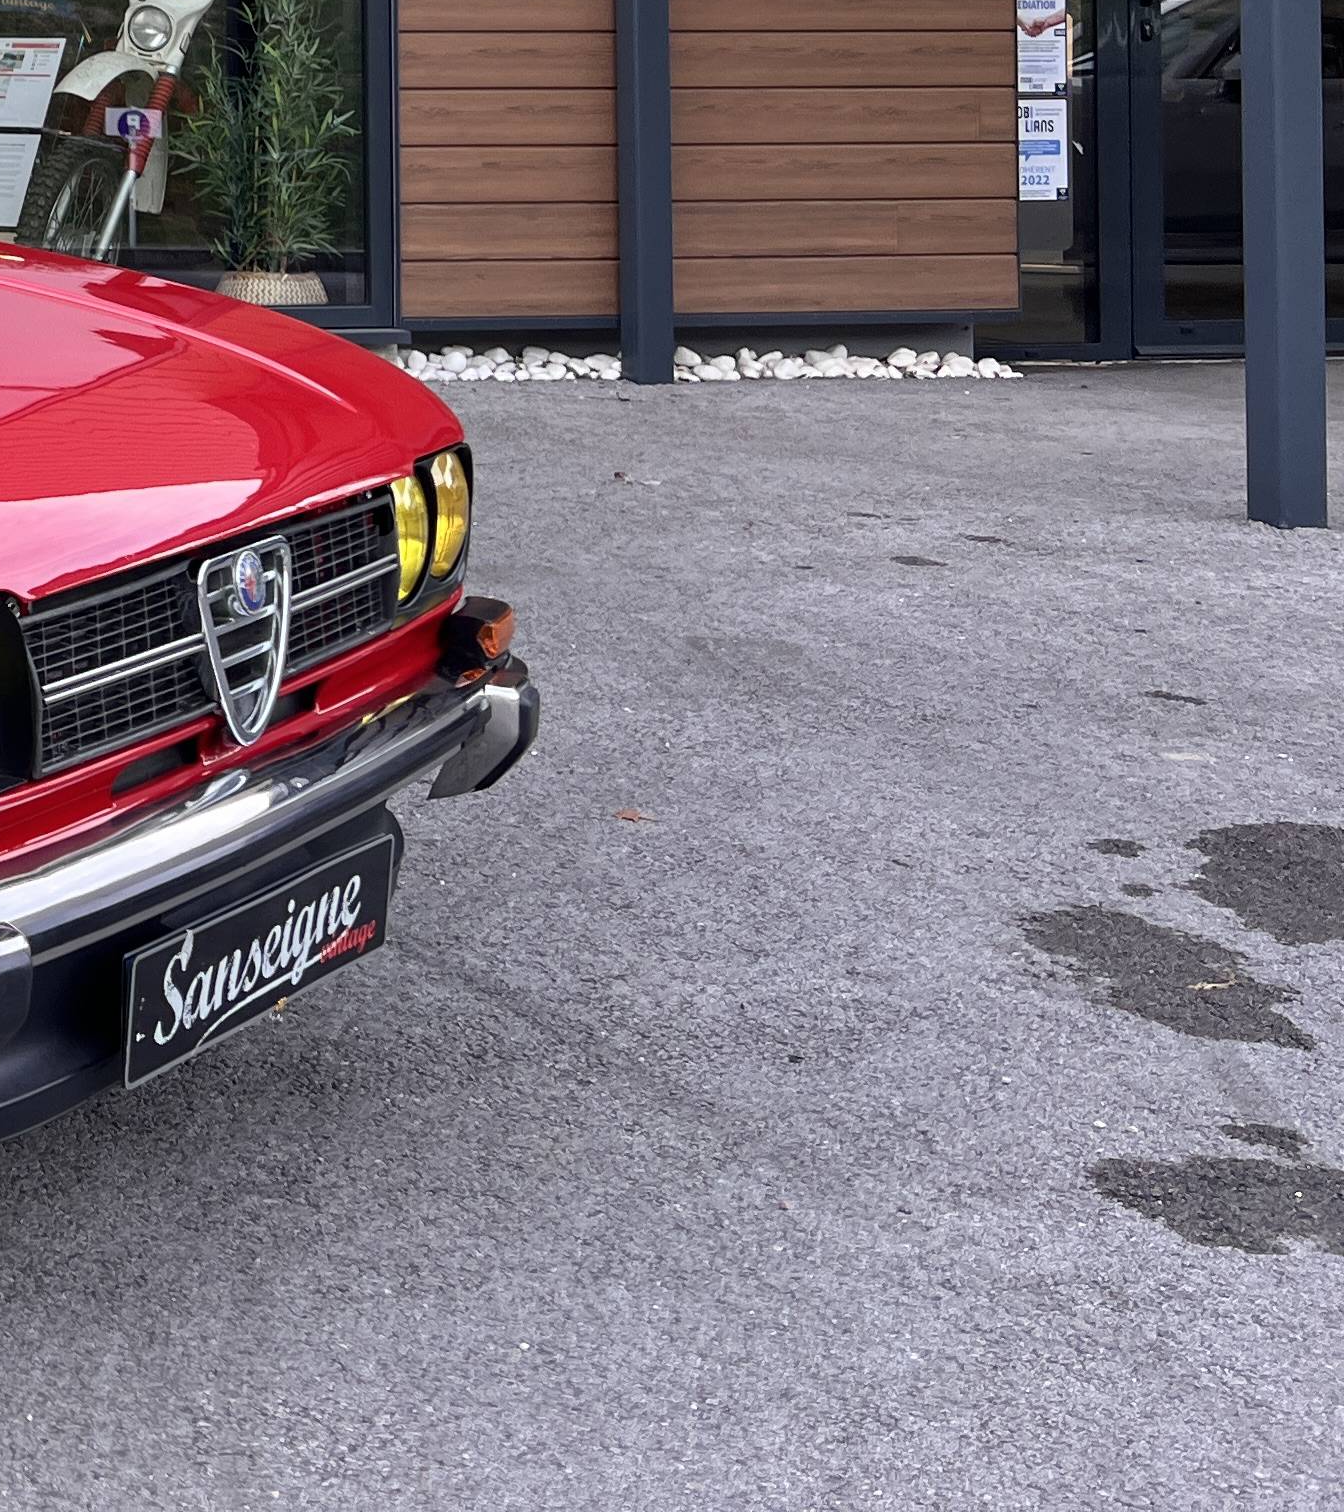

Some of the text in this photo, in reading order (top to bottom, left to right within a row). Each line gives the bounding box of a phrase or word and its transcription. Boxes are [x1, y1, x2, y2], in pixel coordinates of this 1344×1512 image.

[1017, 106, 1033, 119] OBI
[1021, 175, 1050, 186] 2022
[154, 874, 362, 1046] Sanseigne
